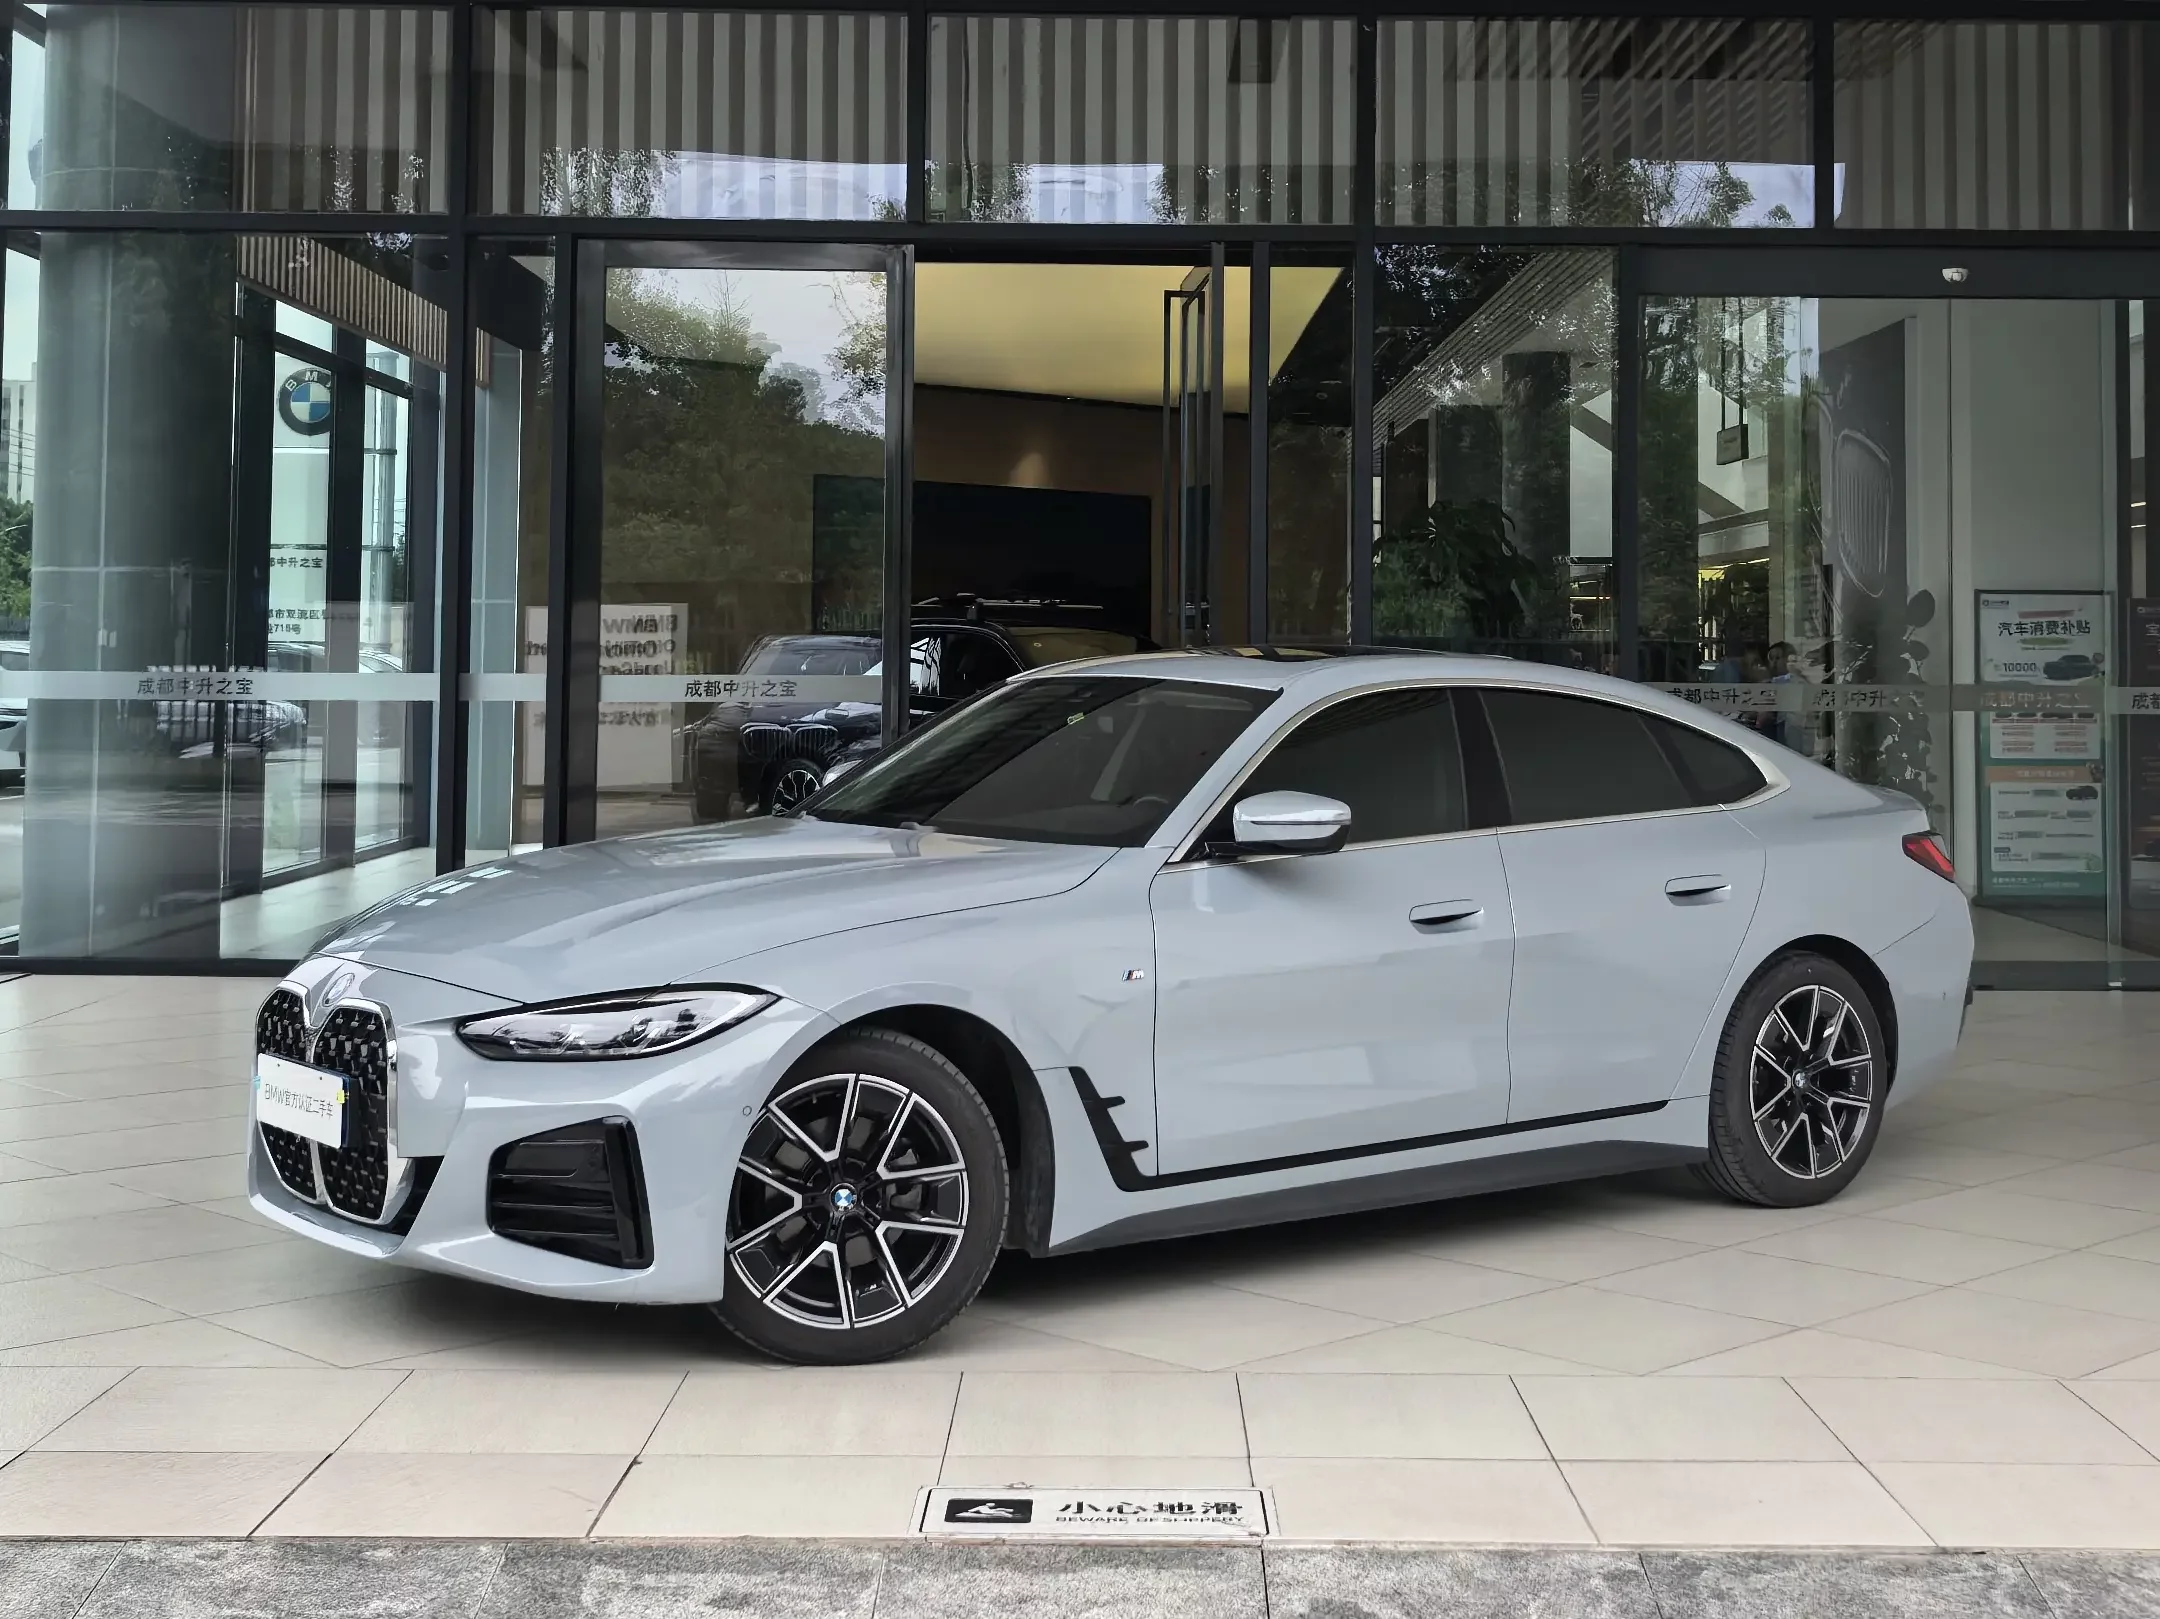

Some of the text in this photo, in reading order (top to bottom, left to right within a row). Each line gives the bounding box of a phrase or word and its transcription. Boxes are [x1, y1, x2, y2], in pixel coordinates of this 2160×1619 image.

[1997, 619, 2091, 637] 汽车消费补贴
[137, 676, 254, 696] 成都中升之宝
[684, 679, 798, 698] 成都中升之宝
[1058, 1500, 1244, 1515] 小心地滑
